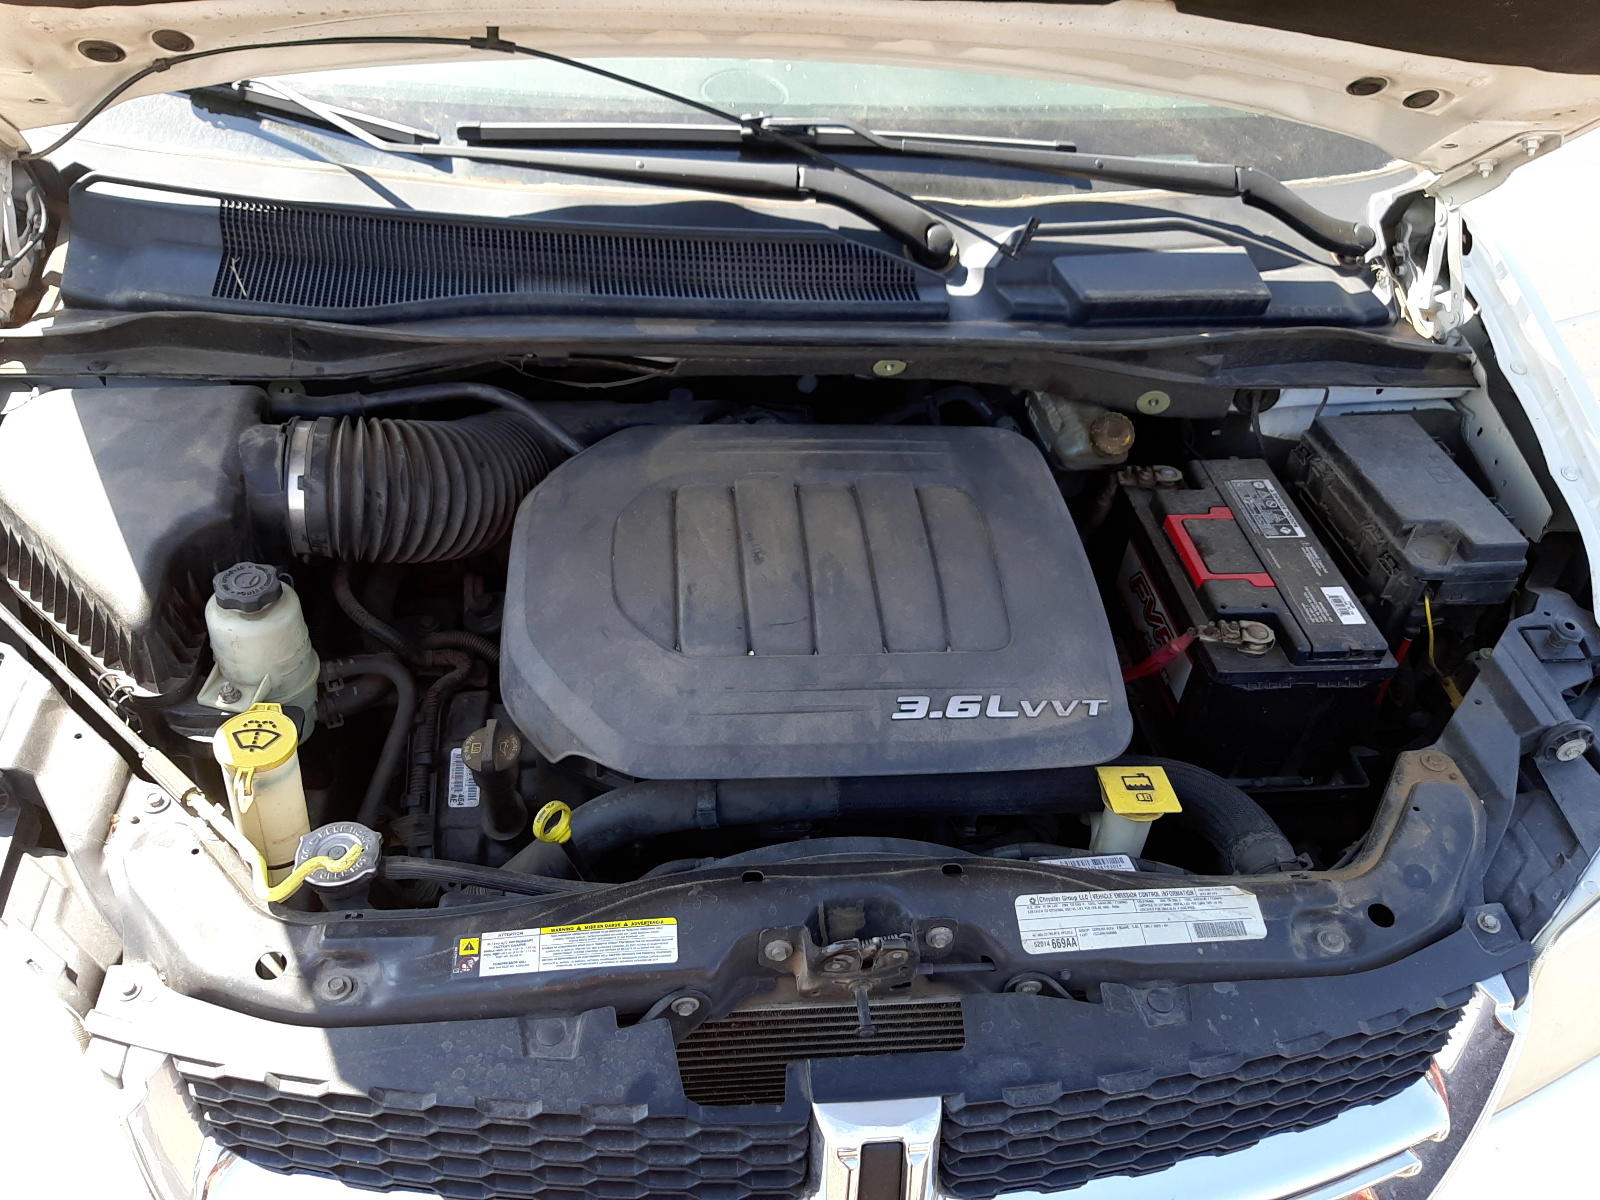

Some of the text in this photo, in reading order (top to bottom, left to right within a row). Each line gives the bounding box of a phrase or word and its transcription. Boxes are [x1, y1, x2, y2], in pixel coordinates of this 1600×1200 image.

[891, 694, 1108, 720] 3.6L VVT
[1039, 893, 1089, 905] Chrysler Group LLC
[1093, 892, 1113, 900] VEHICLE
[1114, 891, 1137, 899] EMISSION
[1138, 890, 1160, 898] CONTROL
[1161, 889, 1194, 898] INFORMATION
[551, 925, 575, 933] WARNING
[1051, 937, 1078, 949] 669AA
